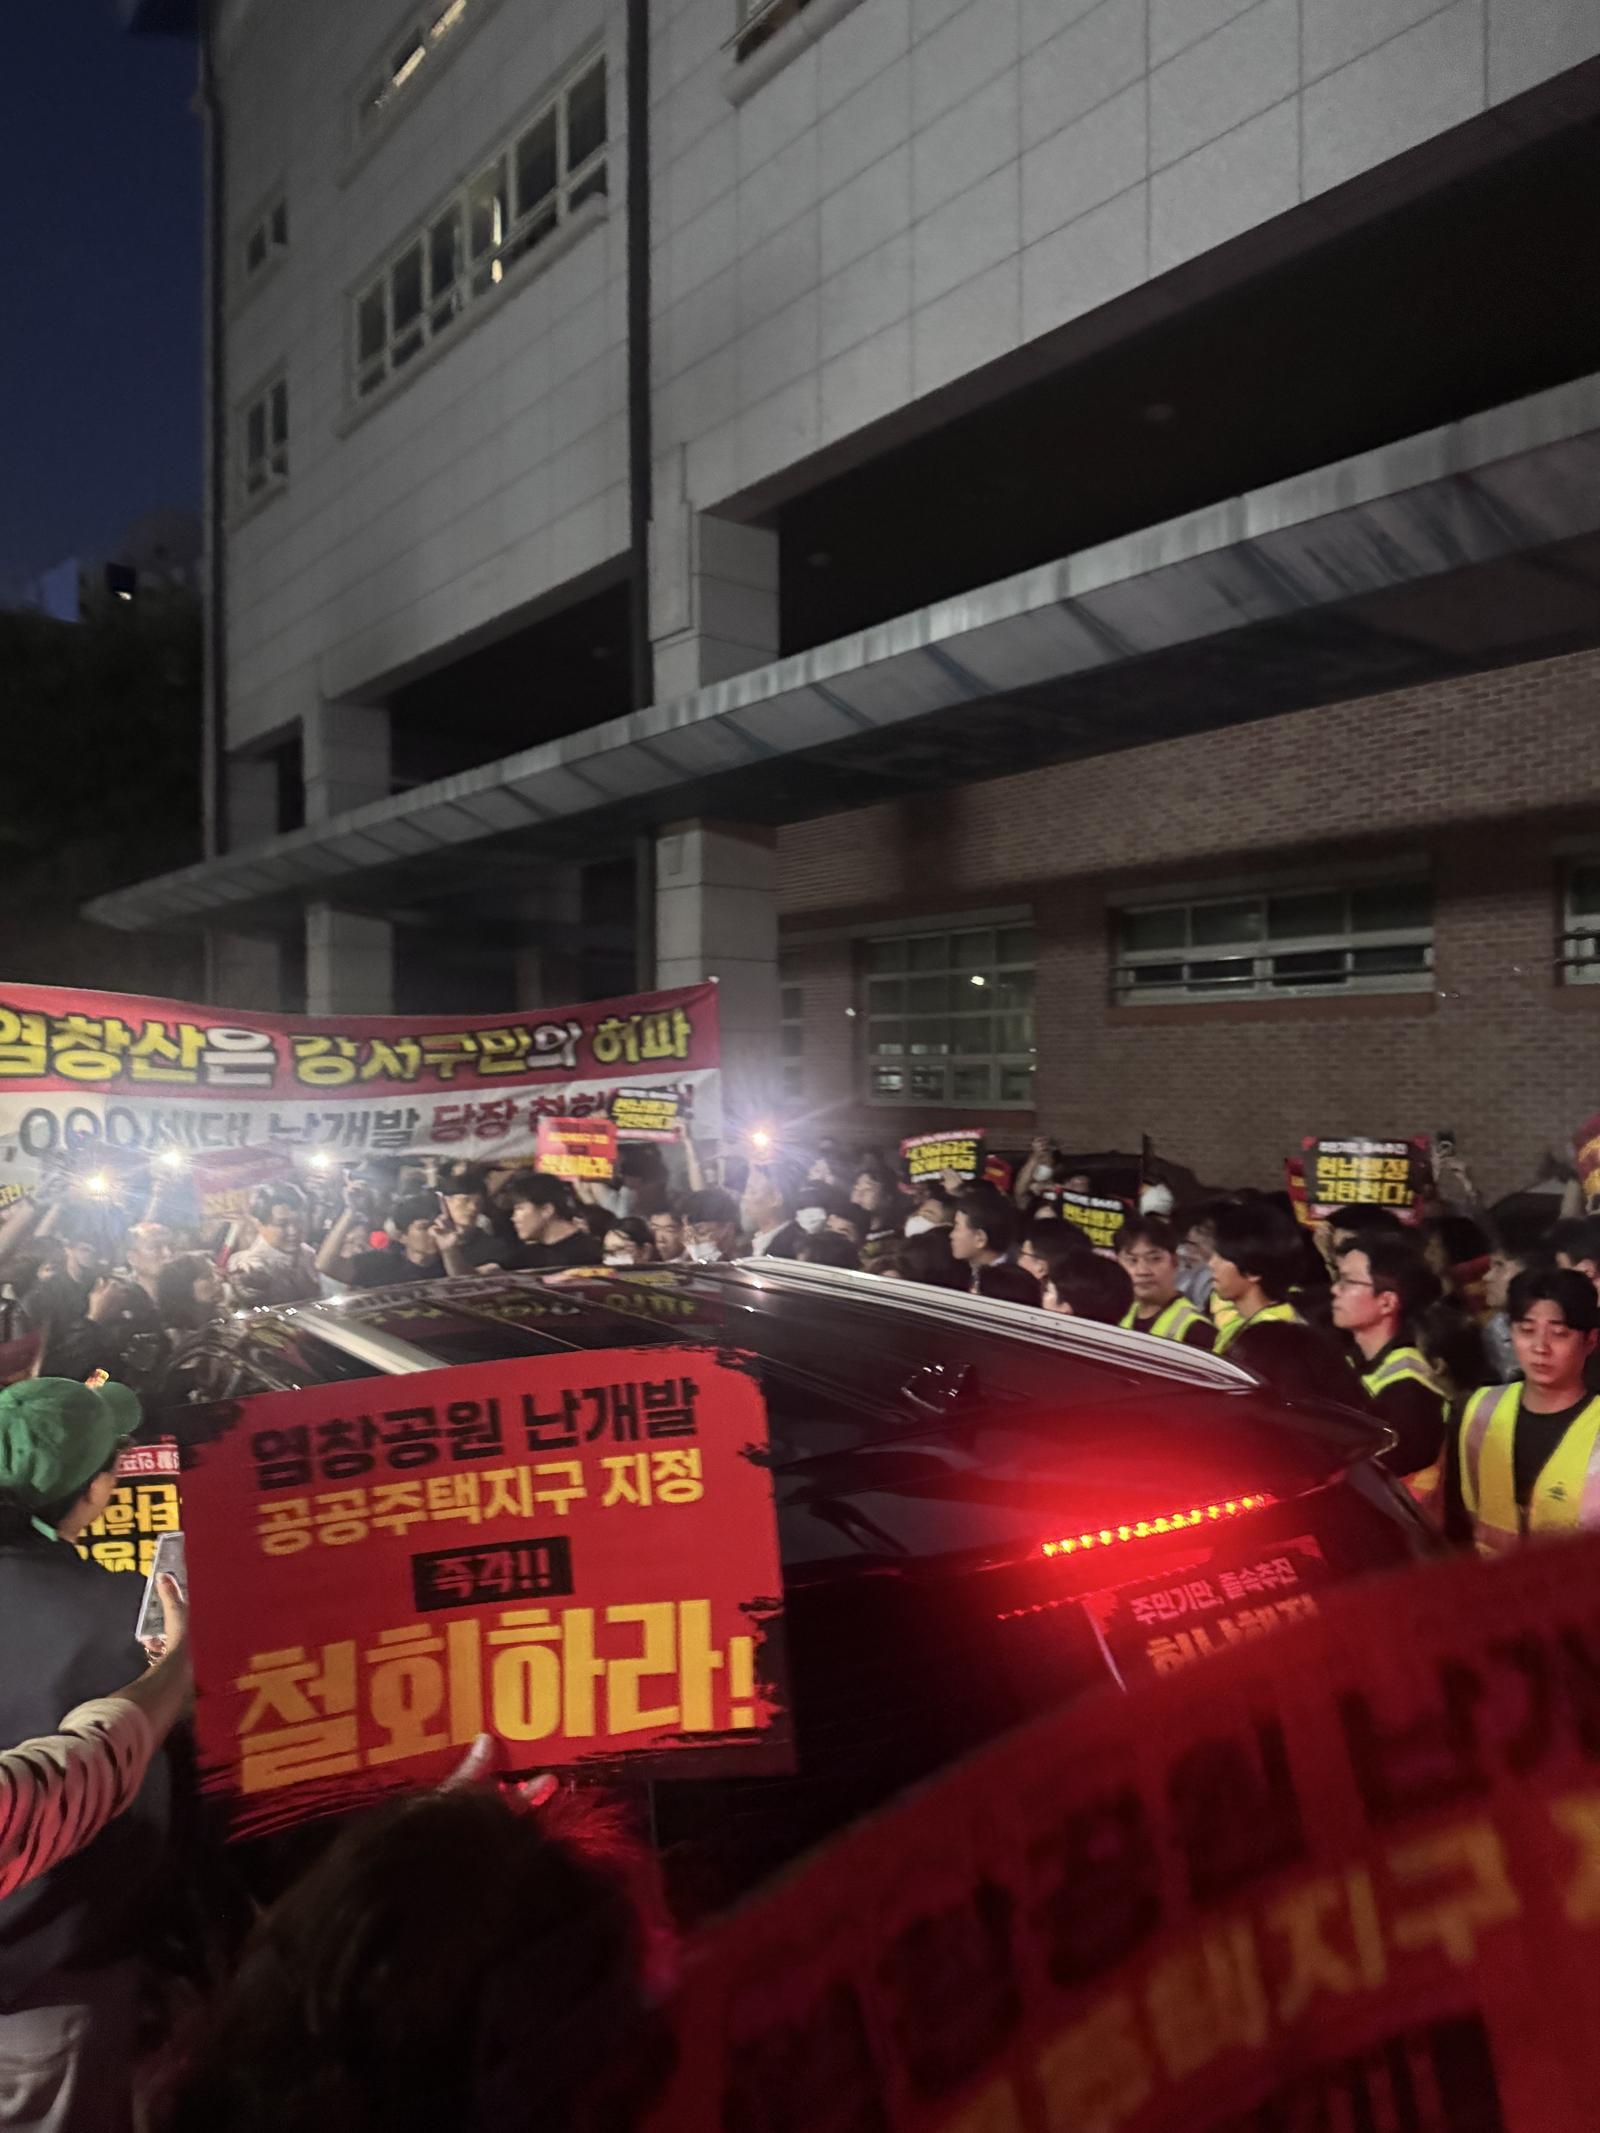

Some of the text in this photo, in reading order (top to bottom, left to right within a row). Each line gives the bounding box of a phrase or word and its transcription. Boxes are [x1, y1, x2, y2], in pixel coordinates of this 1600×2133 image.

[0, 1006, 692, 1086] 염창산은 강서구민의 허파
[268, 1107, 420, 1149] 난개발
[430, 1099, 519, 1142] 당장
[250, 1375, 699, 1491] 염창공원 난개발
[257, 1448, 705, 1557] 공공주택지구 지정
[428, 1544, 553, 1597] 즉각!!
[1130, 1579, 1224, 1625] 주민기만,
[237, 1599, 755, 1794] 철회하라!
